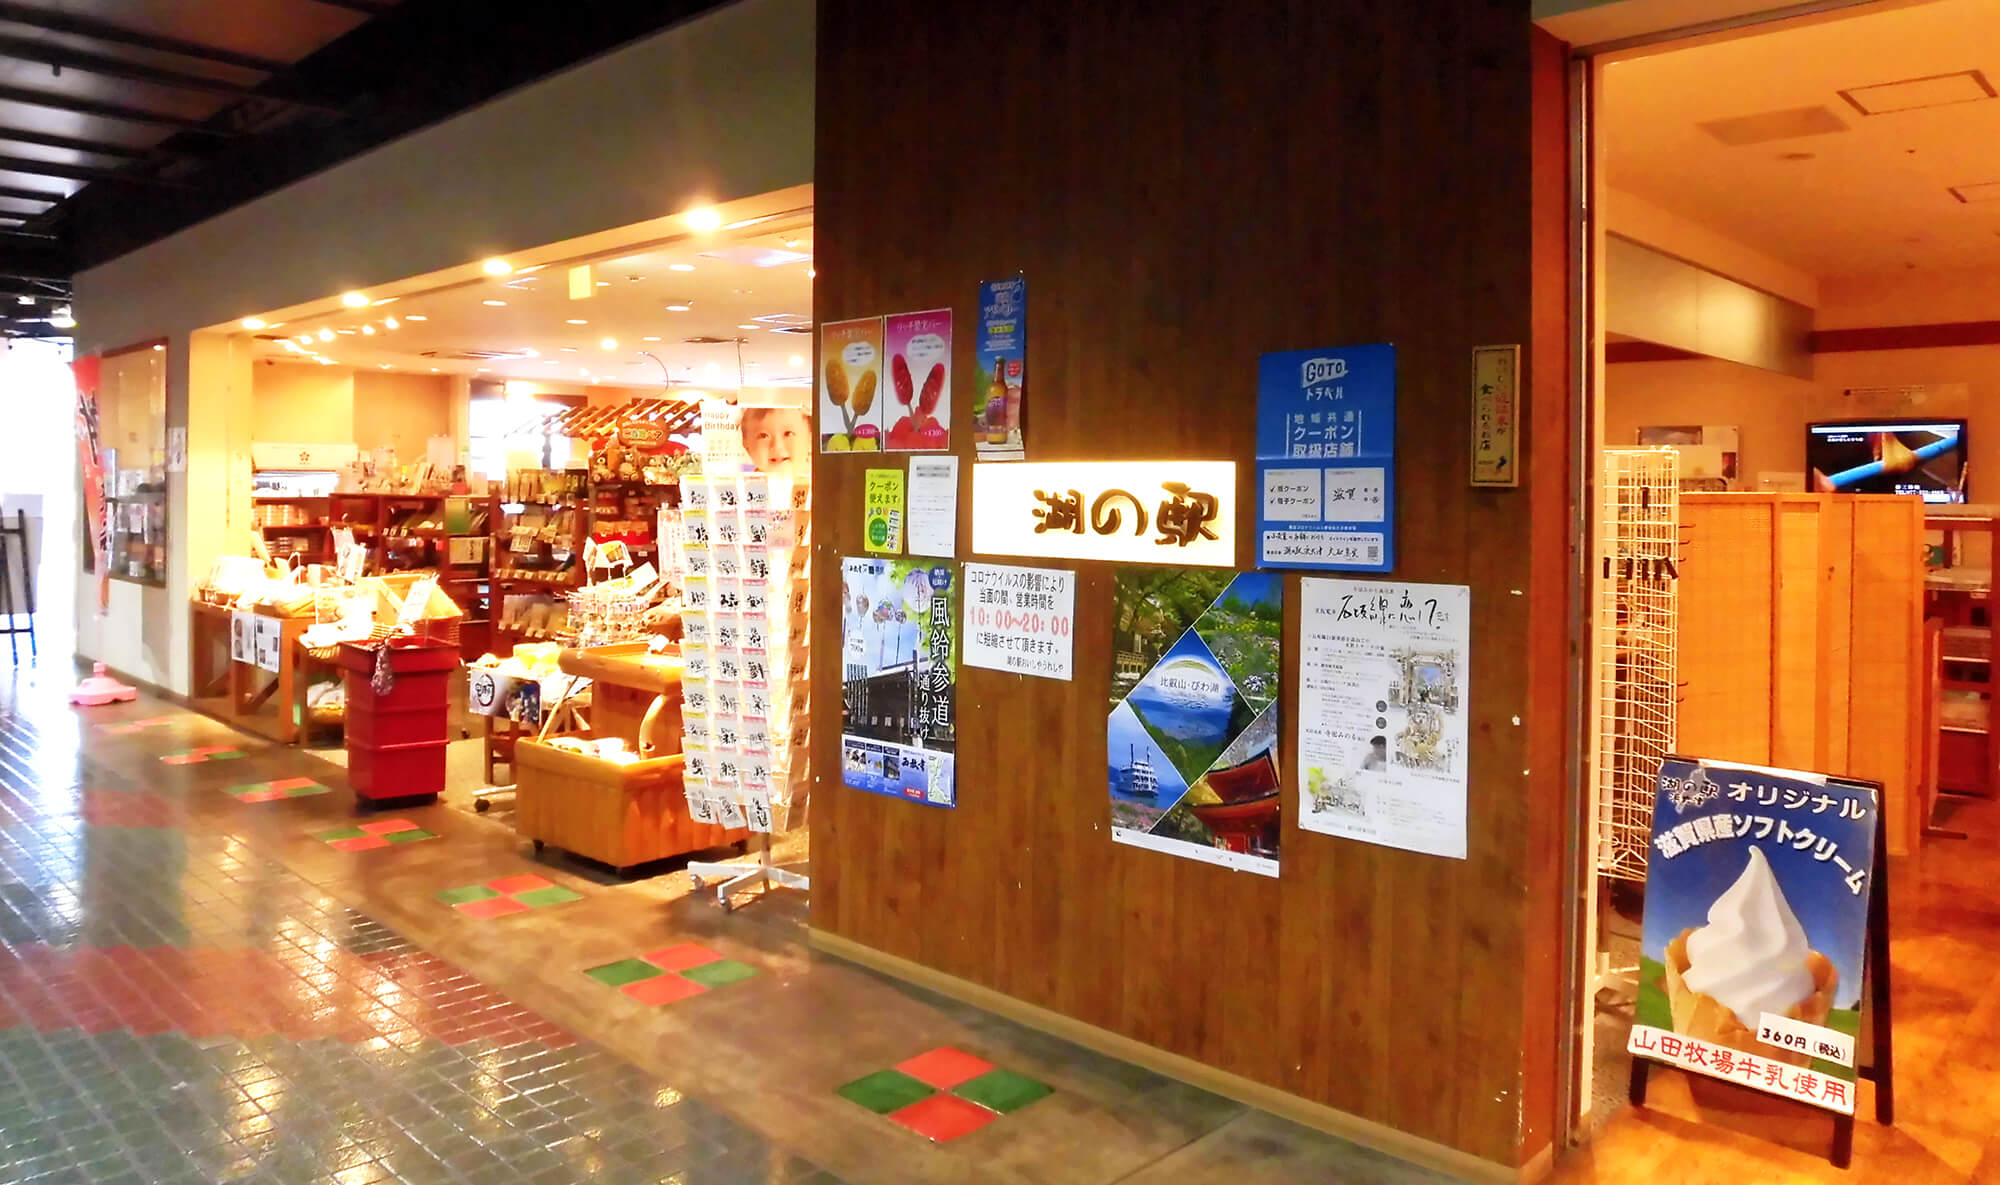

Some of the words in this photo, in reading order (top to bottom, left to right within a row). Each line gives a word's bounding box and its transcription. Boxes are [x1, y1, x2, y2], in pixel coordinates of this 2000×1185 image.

[1306, 386, 1343, 400] トラベル
[1294, 425, 1354, 441] クーポン
[1293, 442, 1354, 458] 取扱店舗
[870, 481, 899, 491] クーポン
[1031, 481, 1219, 547] 湖の駅
[971, 571, 1065, 593] コロナウイルスの影響により
[979, 587, 1054, 610] 当面の間、営業時間を
[976, 632, 1059, 655] に短縮させて頂きます。
[930, 597, 951, 727] 風鈴参道
[1160, 675, 1219, 693] 比叡山・びわ湖
[919, 674, 931, 740] 通り抜け
[1661, 776, 1720, 799] 湖の駅
[1727, 781, 1867, 820] オリジナル
[1653, 813, 1866, 896] 滋賀県産ソフトクリーム
[1633, 1029, 1848, 1106] 山田牧場牛乳使用
